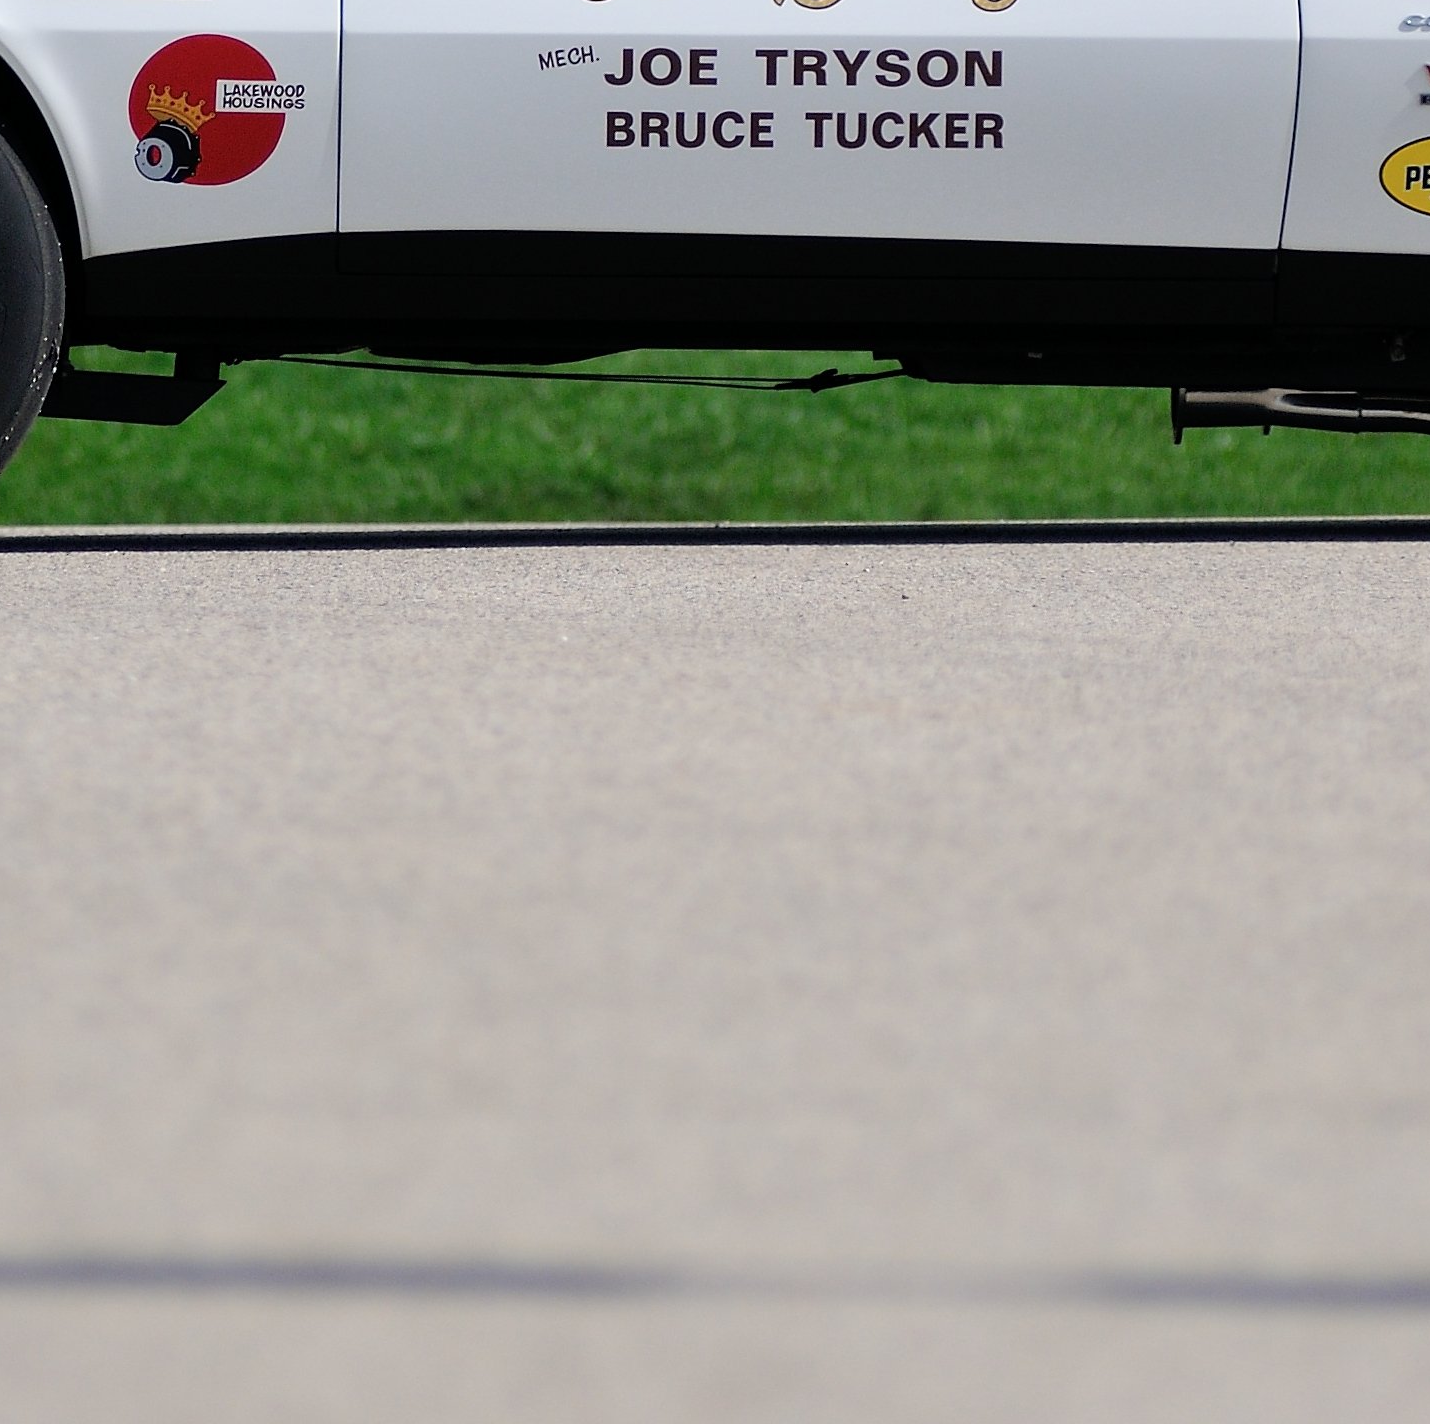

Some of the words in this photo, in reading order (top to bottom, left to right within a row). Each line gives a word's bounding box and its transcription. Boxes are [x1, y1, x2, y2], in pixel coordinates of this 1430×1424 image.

[538, 45, 600, 71] MECH.
[604, 48, 718, 86] JOE
[756, 49, 1003, 87] TRYSON
[222, 96, 306, 109] HOUSINGS
[223, 84, 305, 98] LAKEWOOD
[605, 111, 774, 149] BRUCE
[805, 111, 1004, 150] TUCKER
